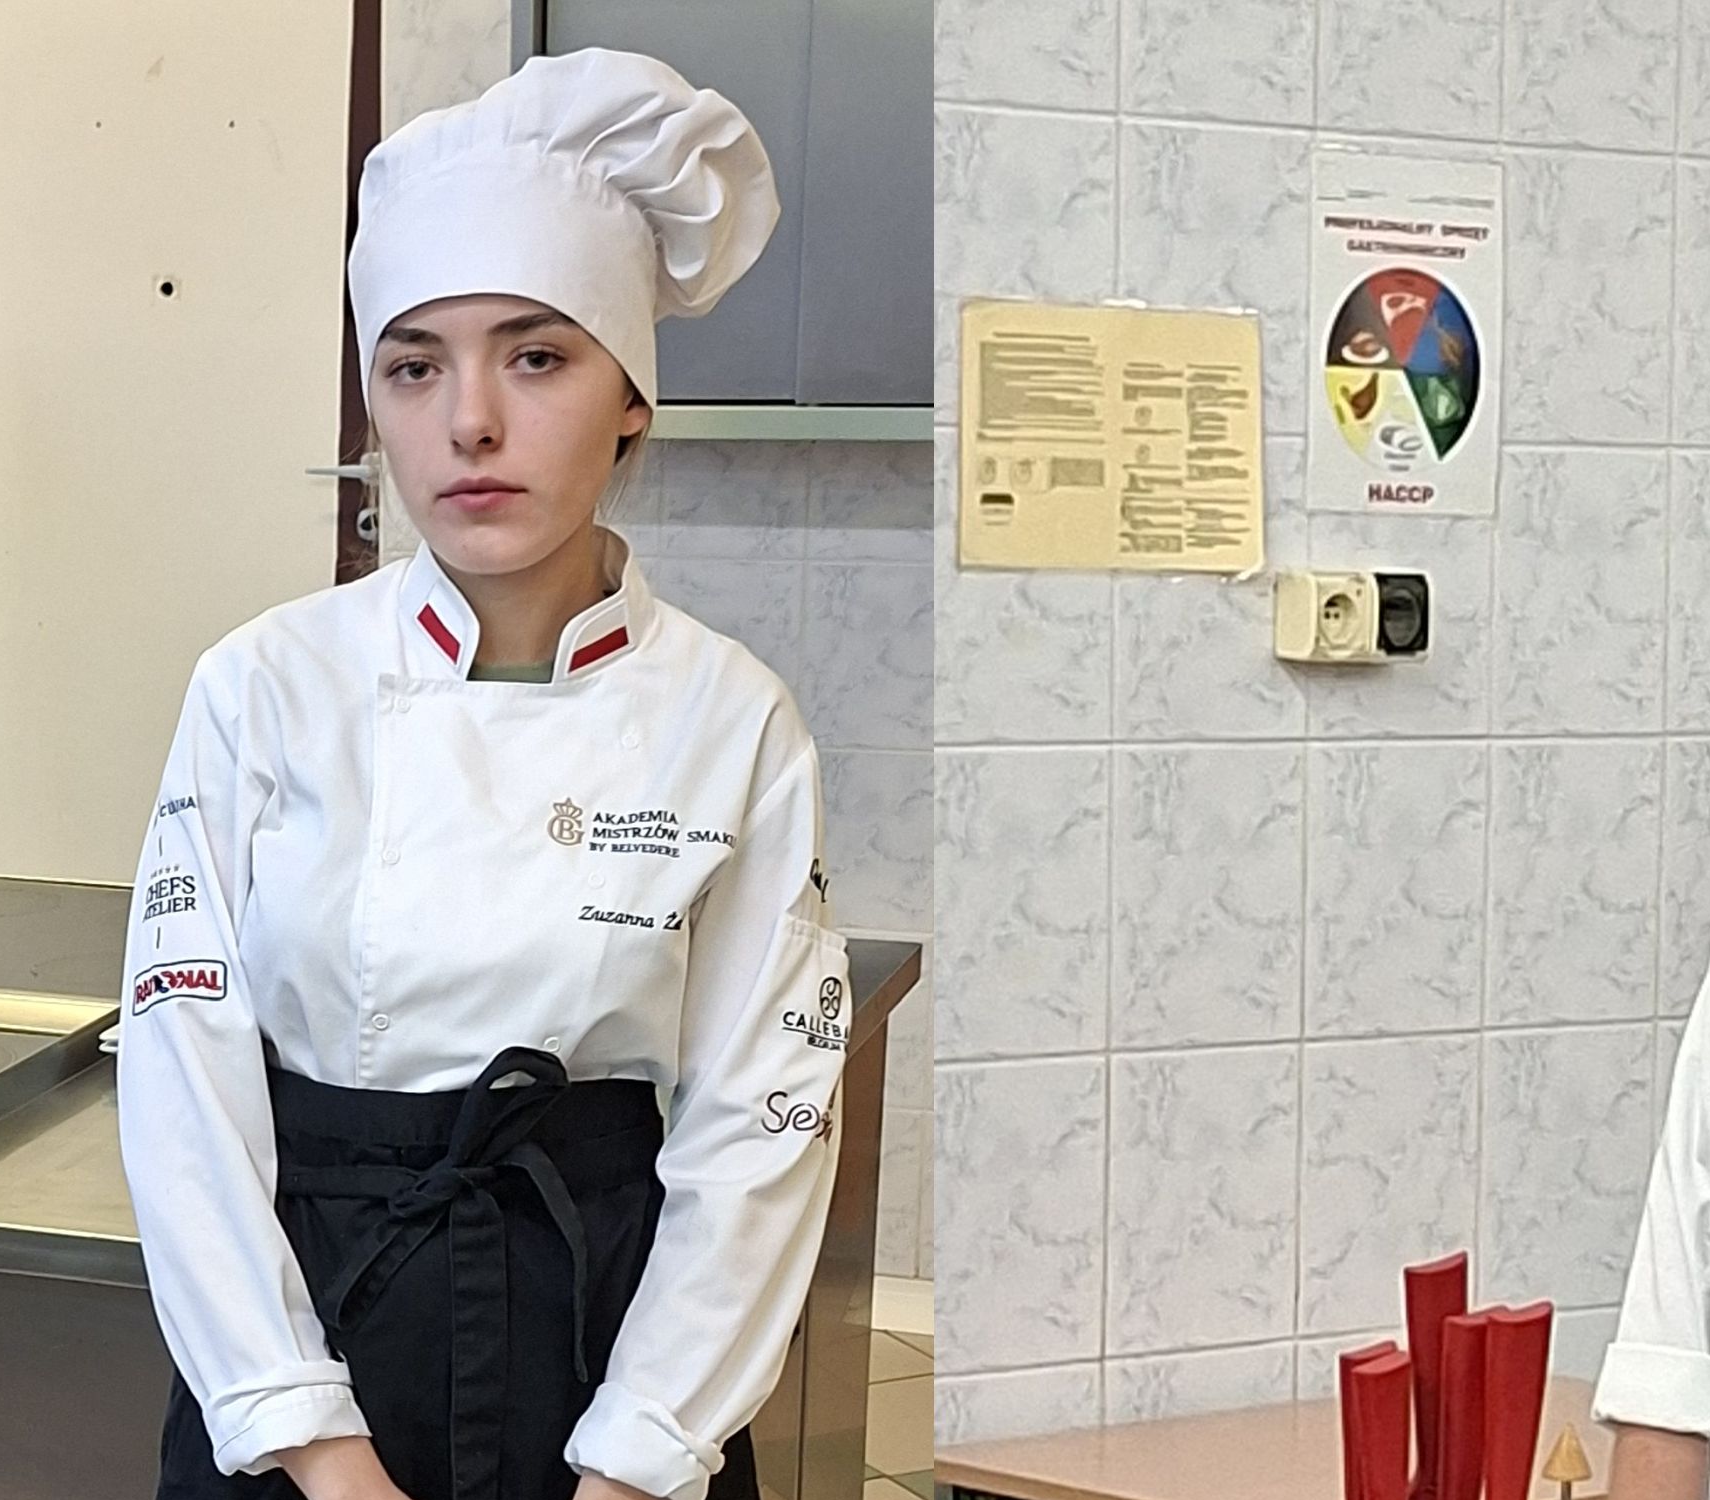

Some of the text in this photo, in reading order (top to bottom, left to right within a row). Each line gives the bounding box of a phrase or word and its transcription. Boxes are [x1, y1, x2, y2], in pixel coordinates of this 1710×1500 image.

[1367, 483, 1434, 503] HACCP
[592, 810, 679, 826] AKADEMIA
[592, 823, 680, 842] MISTRZÓW
[589, 842, 681, 858] BY BELVEDERE
[578, 905, 655, 928] Zuzanna
[782, 1011, 849, 1039] CALLEB
